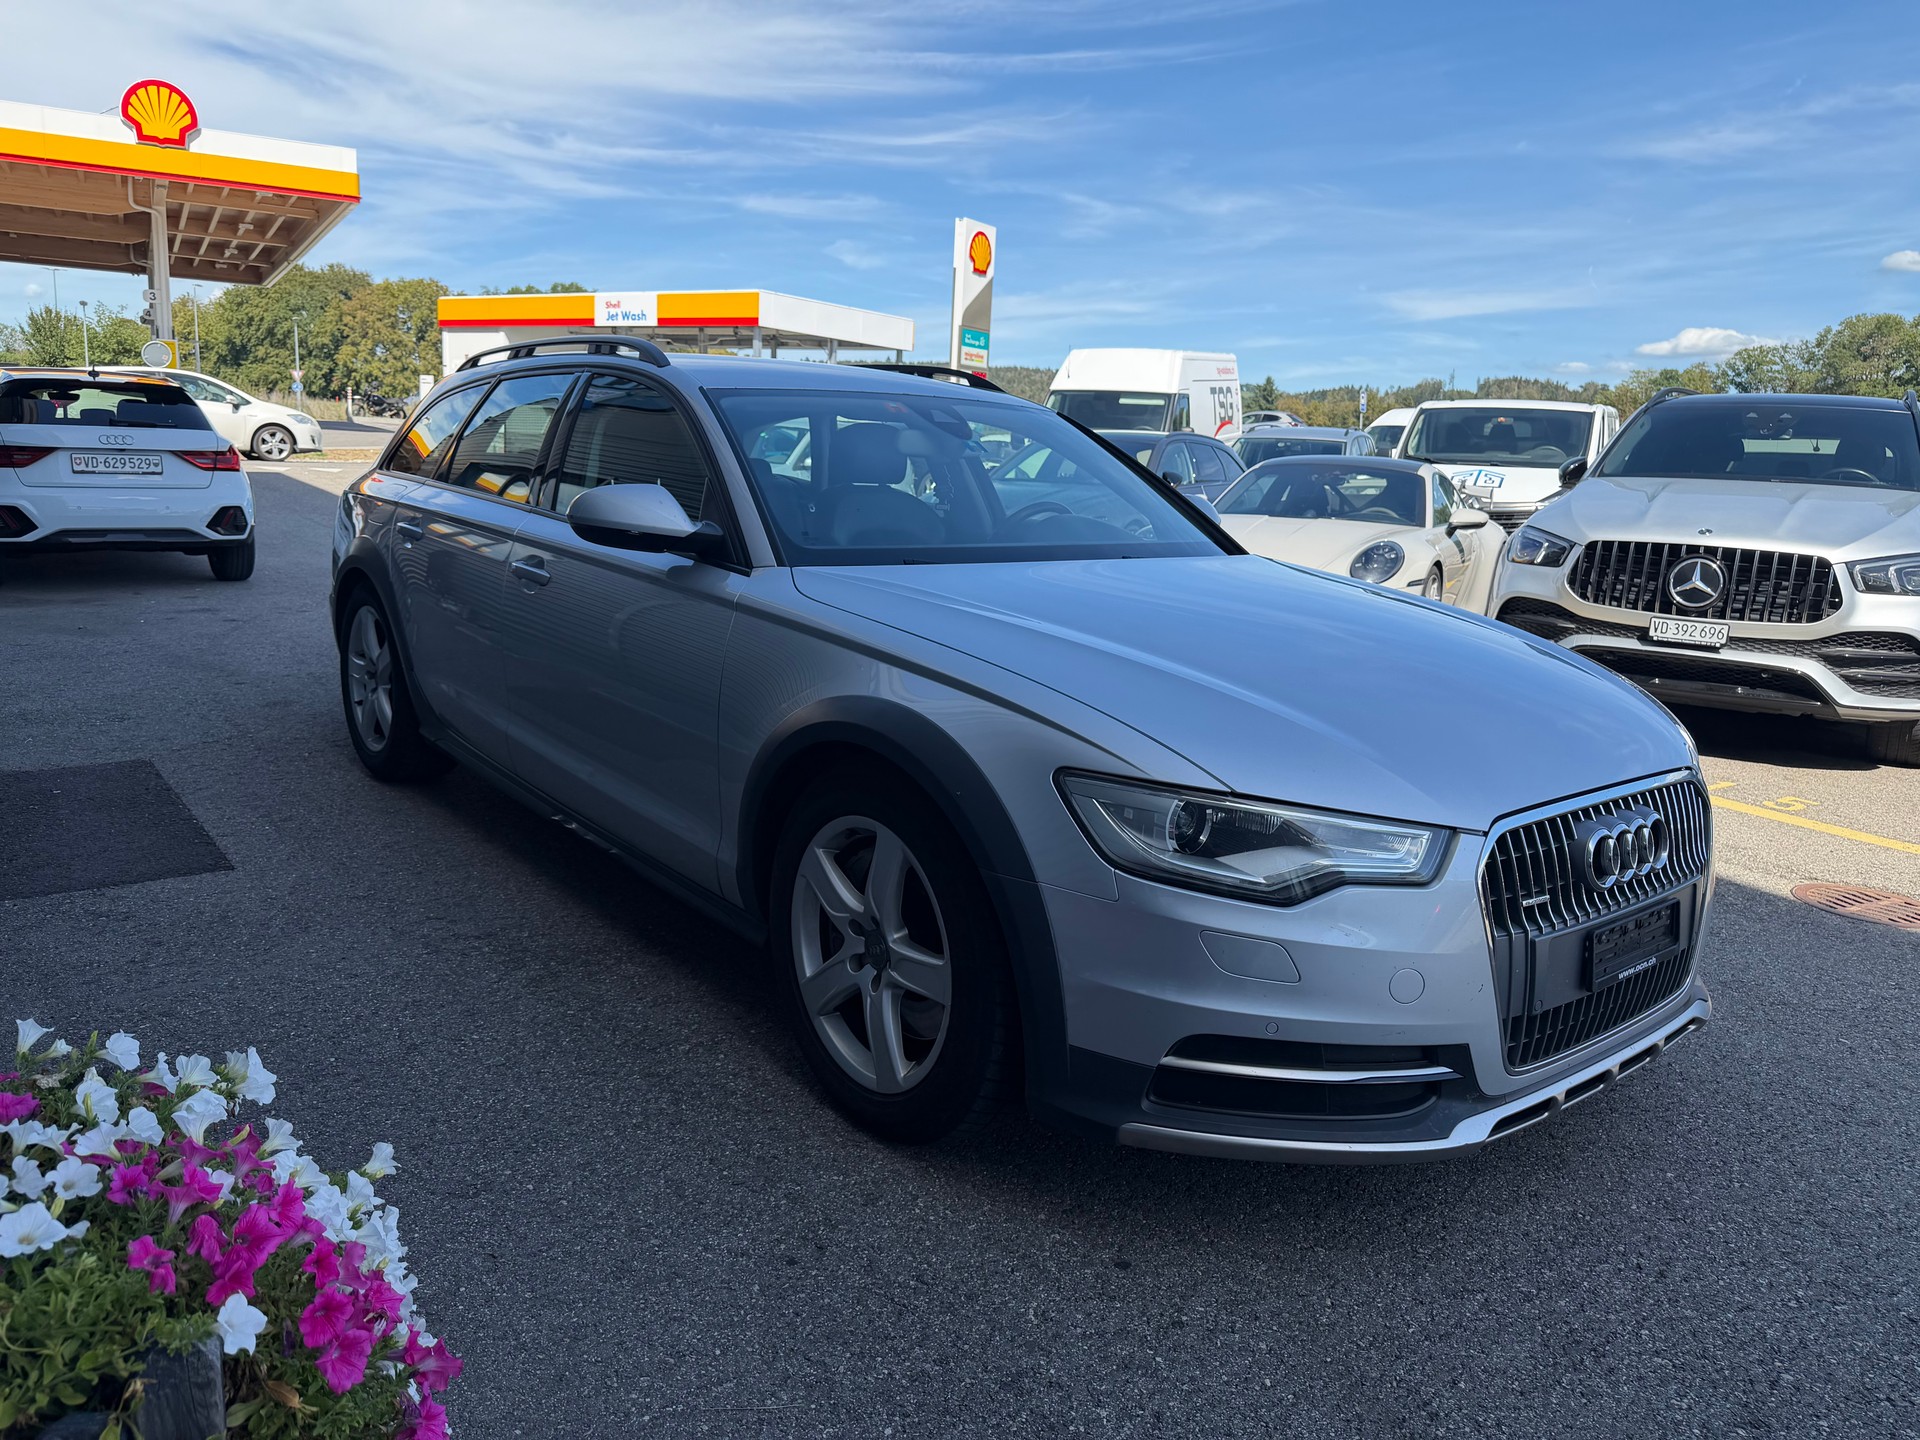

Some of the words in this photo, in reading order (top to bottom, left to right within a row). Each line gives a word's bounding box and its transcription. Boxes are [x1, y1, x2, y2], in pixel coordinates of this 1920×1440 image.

[149, 291, 157, 301] 3
[605, 300, 621, 309] Shell
[606, 311, 619, 321] Jet
[621, 310, 647, 321] Wash
[1210, 386, 1234, 425] TSG
